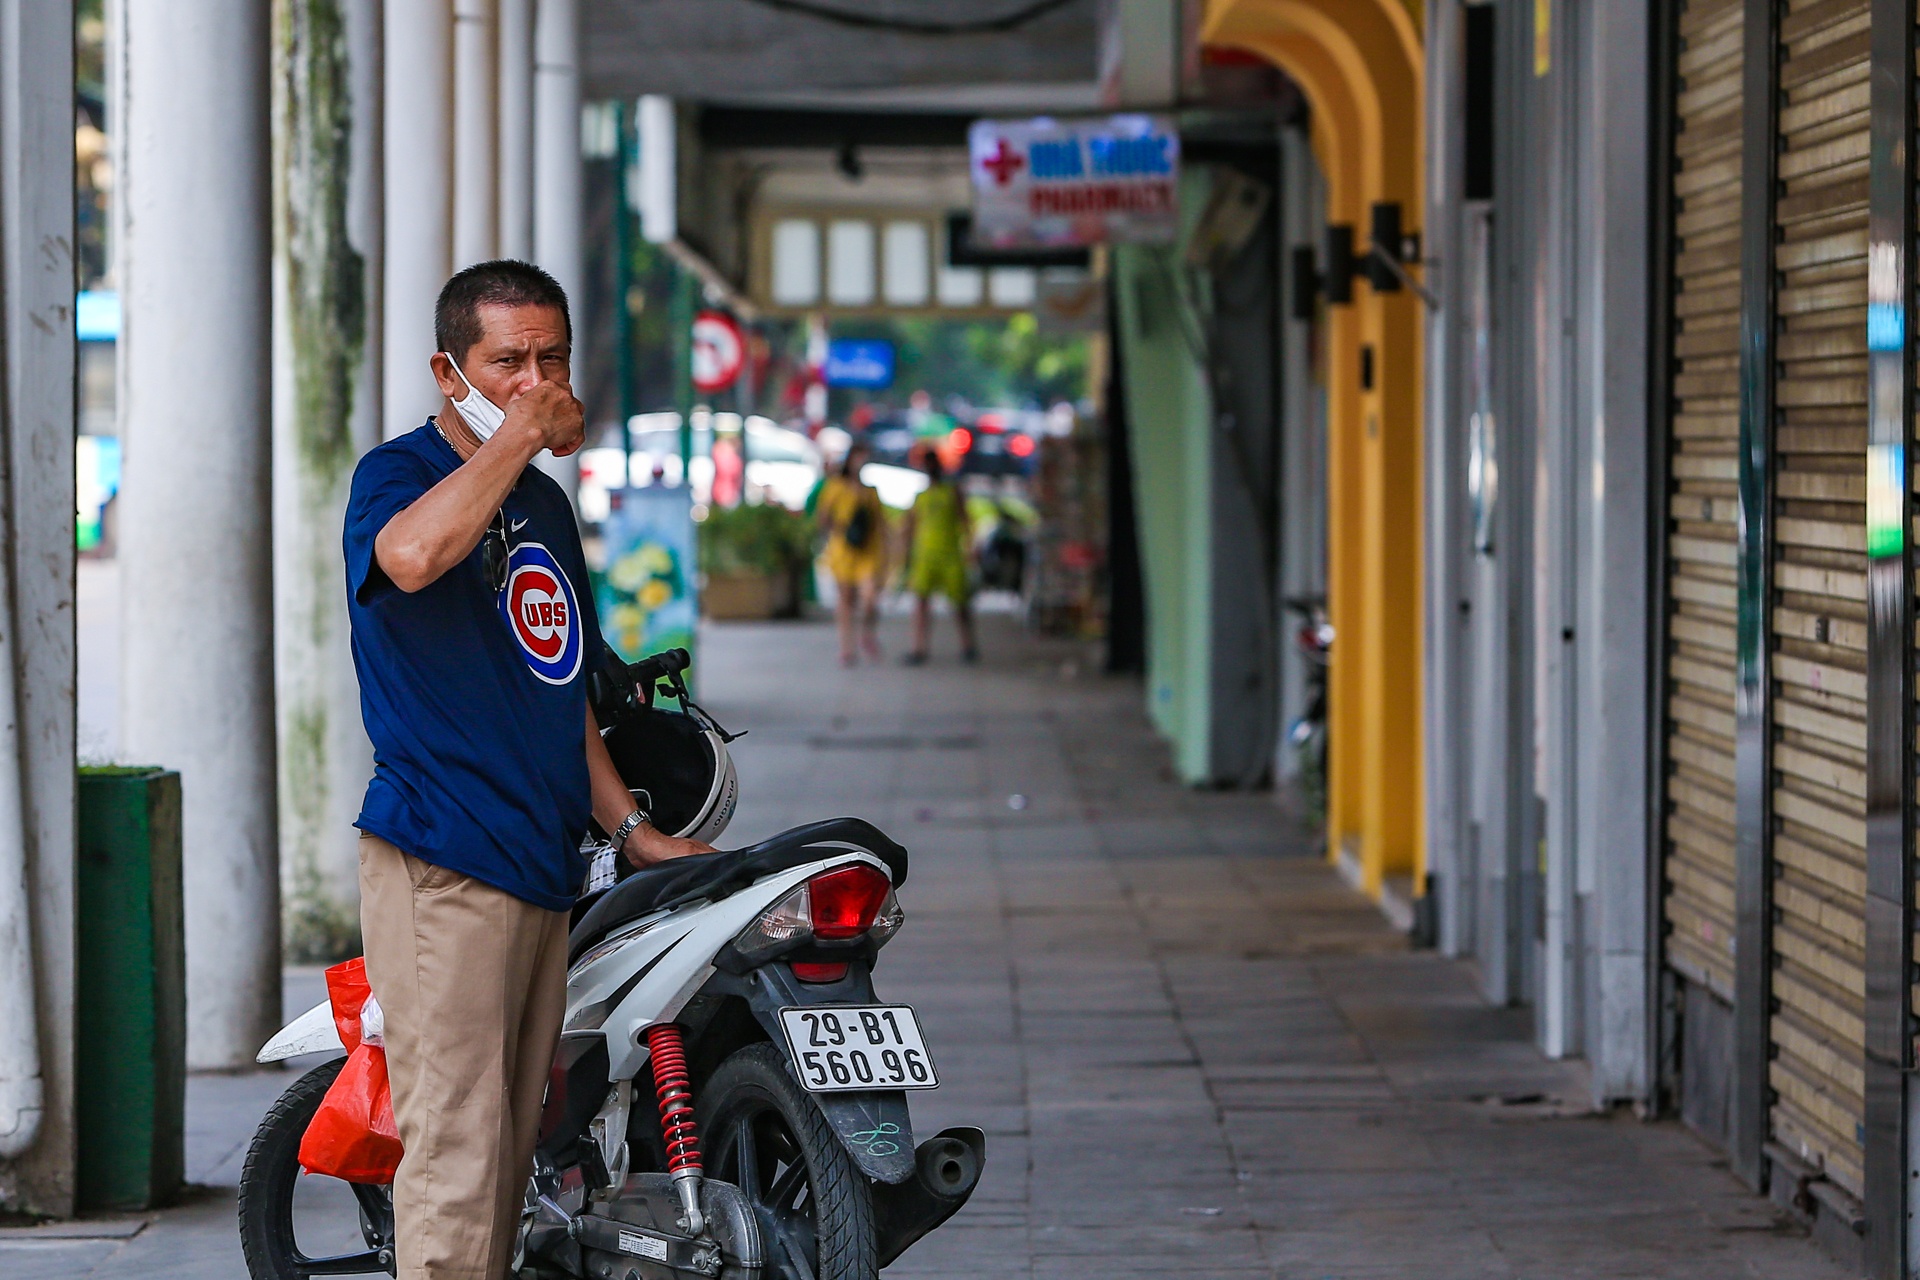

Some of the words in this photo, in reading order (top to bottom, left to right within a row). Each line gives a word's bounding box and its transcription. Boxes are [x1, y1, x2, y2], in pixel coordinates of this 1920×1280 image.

[714, 780, 734, 827] PIAGGIO
[801, 1011, 904, 1046] 29-B1
[802, 1049, 928, 1085] 560.96
